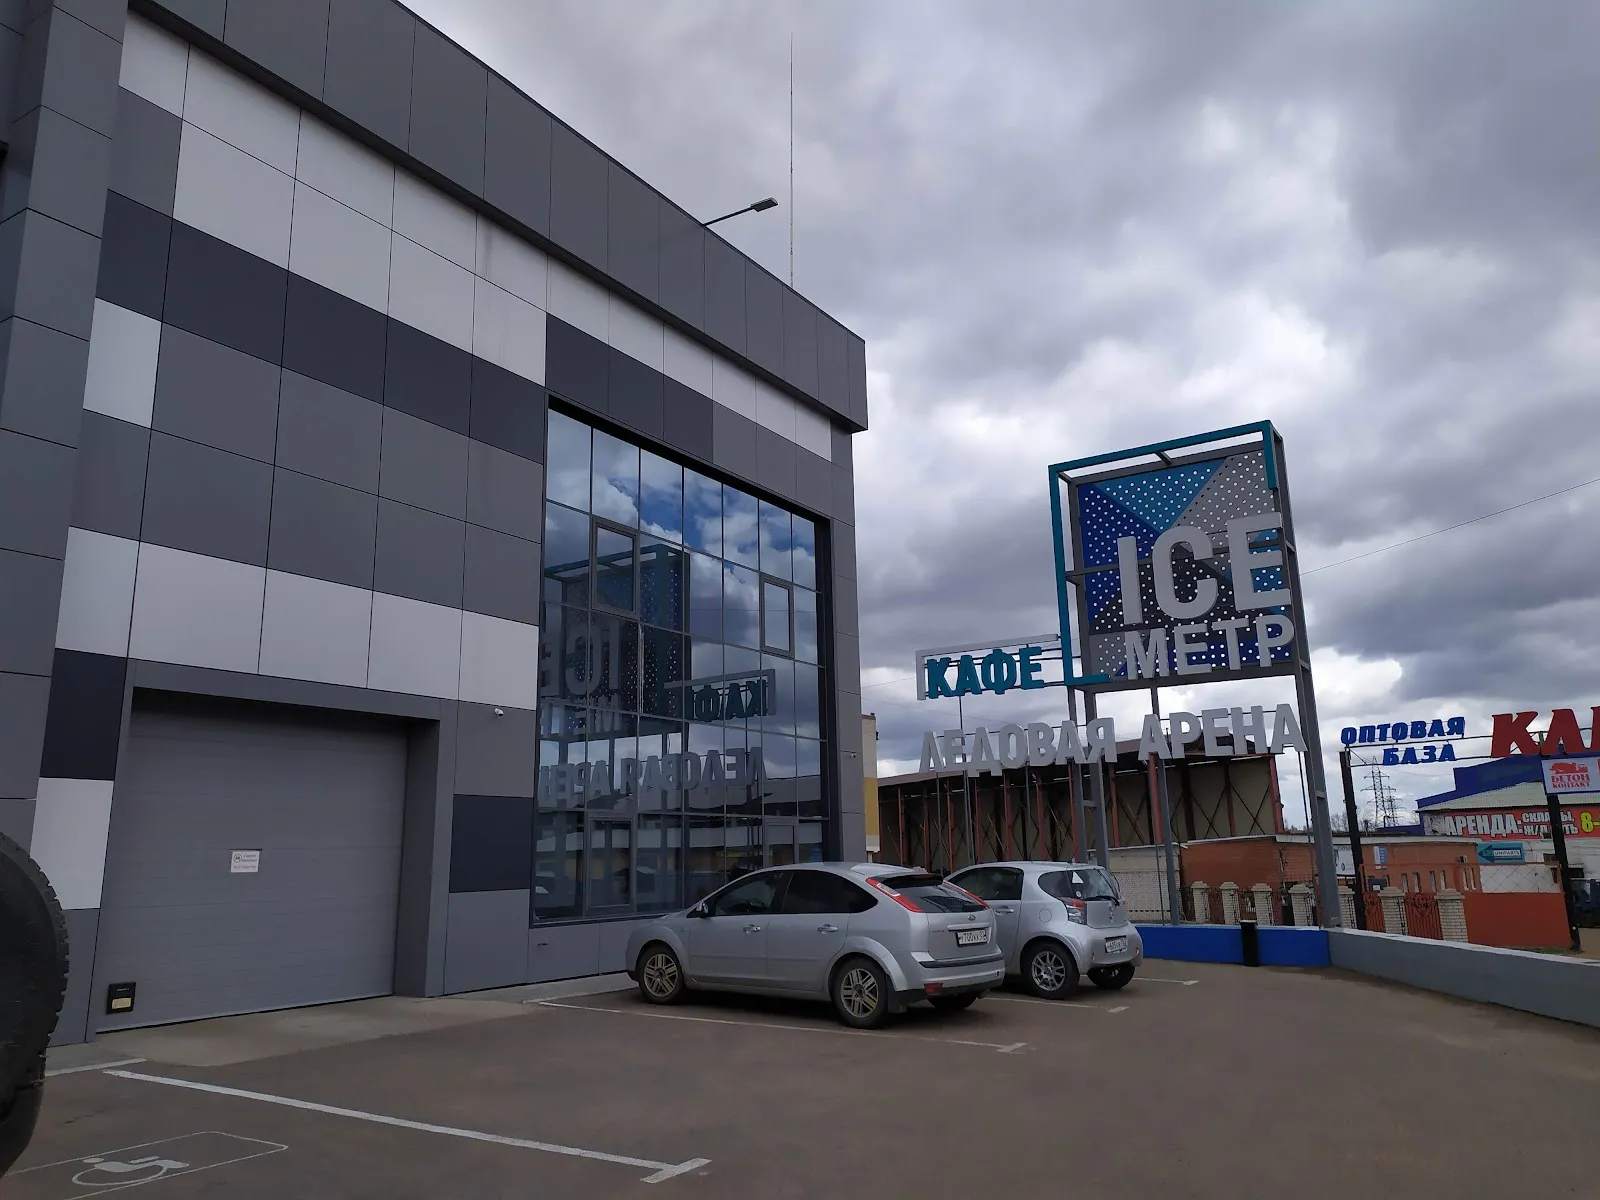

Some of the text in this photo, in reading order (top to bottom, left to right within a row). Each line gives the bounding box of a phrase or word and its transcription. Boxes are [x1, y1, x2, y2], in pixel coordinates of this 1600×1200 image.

[1117, 512, 1291, 625] ICE
[1125, 614, 1295, 680] МЕТР
[927, 646, 1045, 699] КАФЕ
[919, 703, 1308, 777] ЛЕДОВАЯ АРЕНА
[1341, 717, 1465, 745] ОПТОВАЯ
[1383, 744, 1457, 766] БАЗА
[1551, 773, 1590, 782] БЕТОН
[1552, 781, 1590, 789] КОНТАКТ
[1444, 813, 1523, 837] АРЕНДА:
[1522, 810, 1575, 823] СКЛАЫ,
[1580, 811, 1600, 833] 8-
